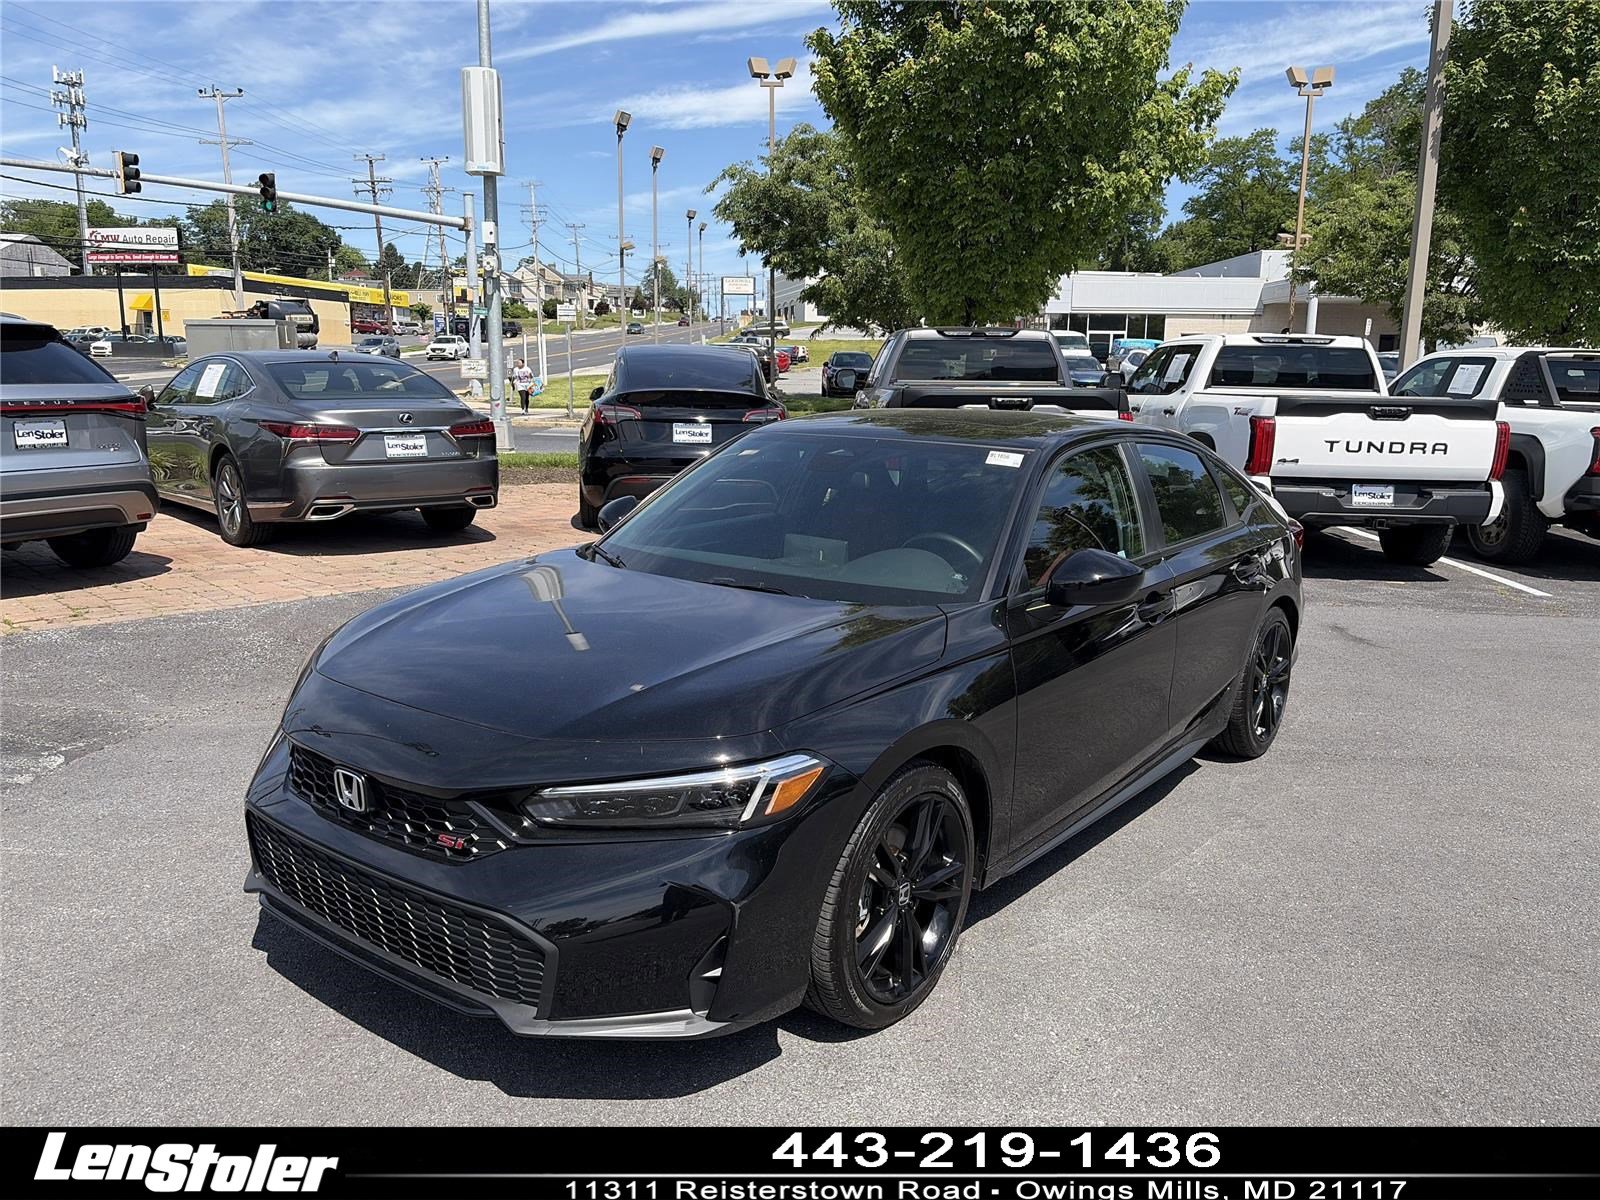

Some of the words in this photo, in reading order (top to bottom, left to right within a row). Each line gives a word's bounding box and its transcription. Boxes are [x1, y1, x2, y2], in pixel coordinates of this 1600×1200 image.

[122, 234, 143, 243] Auto
[145, 234, 175, 244] Repair
[1324, 440, 1448, 455] TUNDRA
